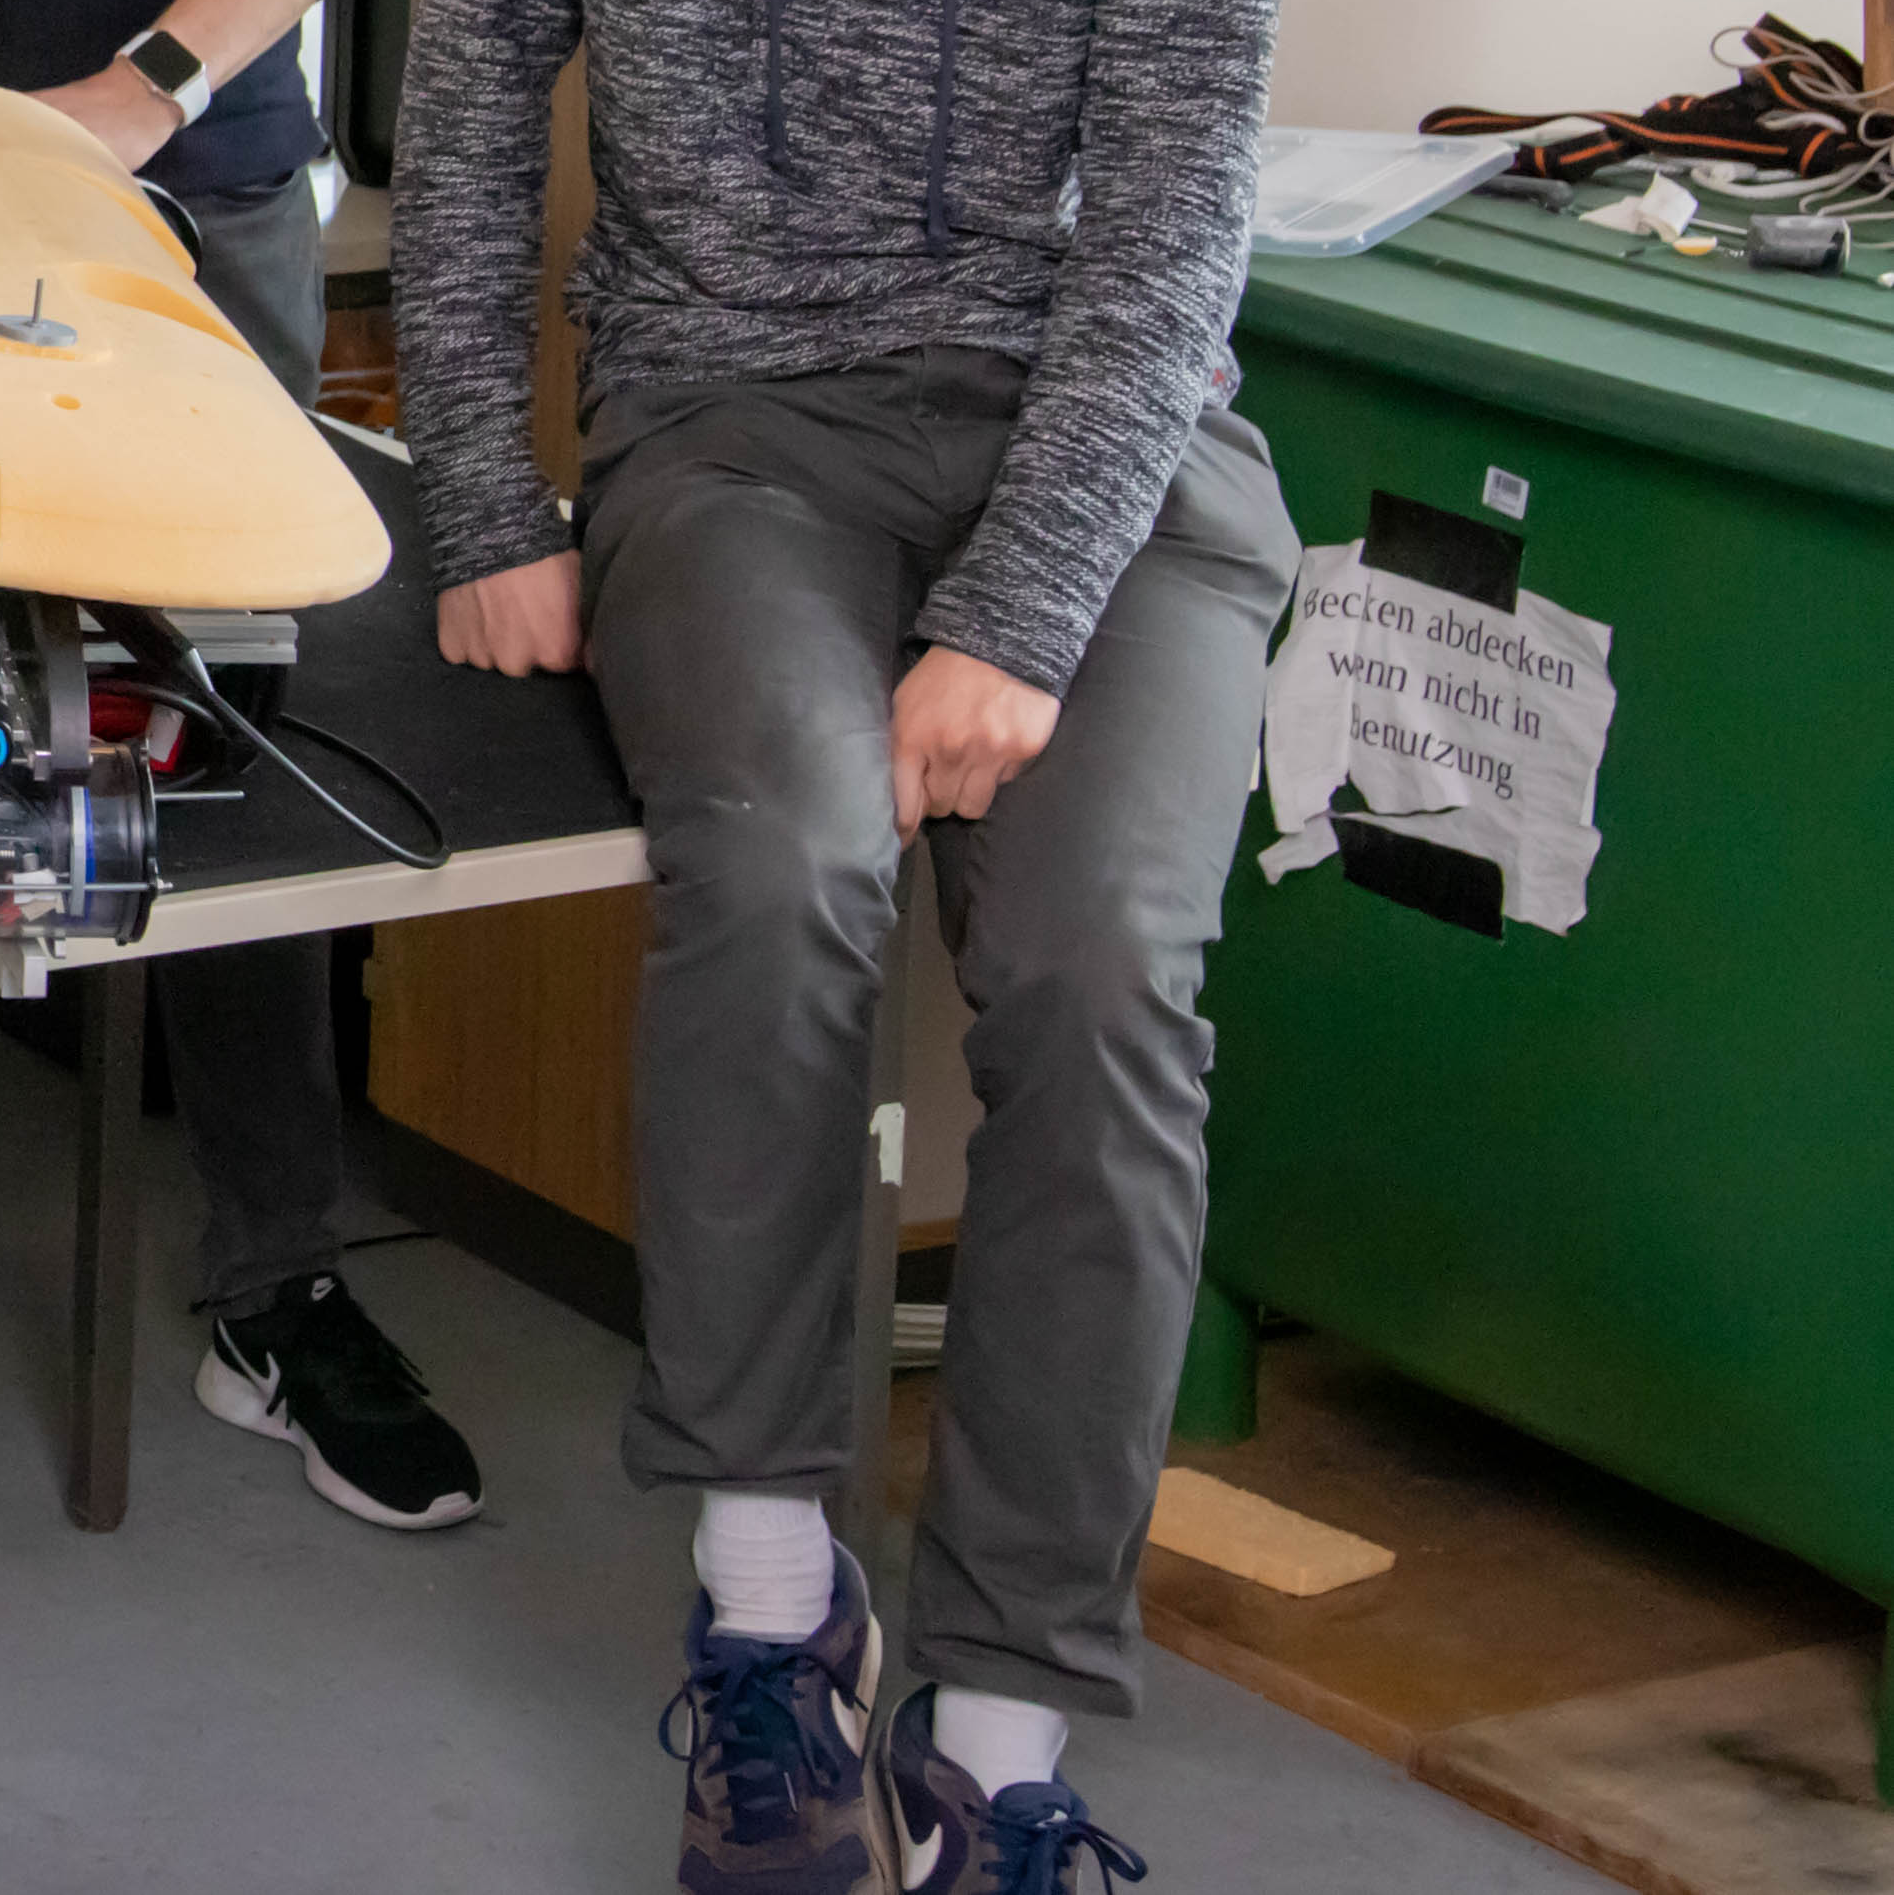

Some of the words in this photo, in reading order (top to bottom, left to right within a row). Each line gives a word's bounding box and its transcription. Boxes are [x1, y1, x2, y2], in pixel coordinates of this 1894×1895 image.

[1304, 583, 1414, 634] Becken
[1427, 608, 1575, 689] abdecken
[1327, 651, 1408, 693] wenn
[1422, 672, 1503, 726] nicht
[1514, 696, 1541, 739] in
